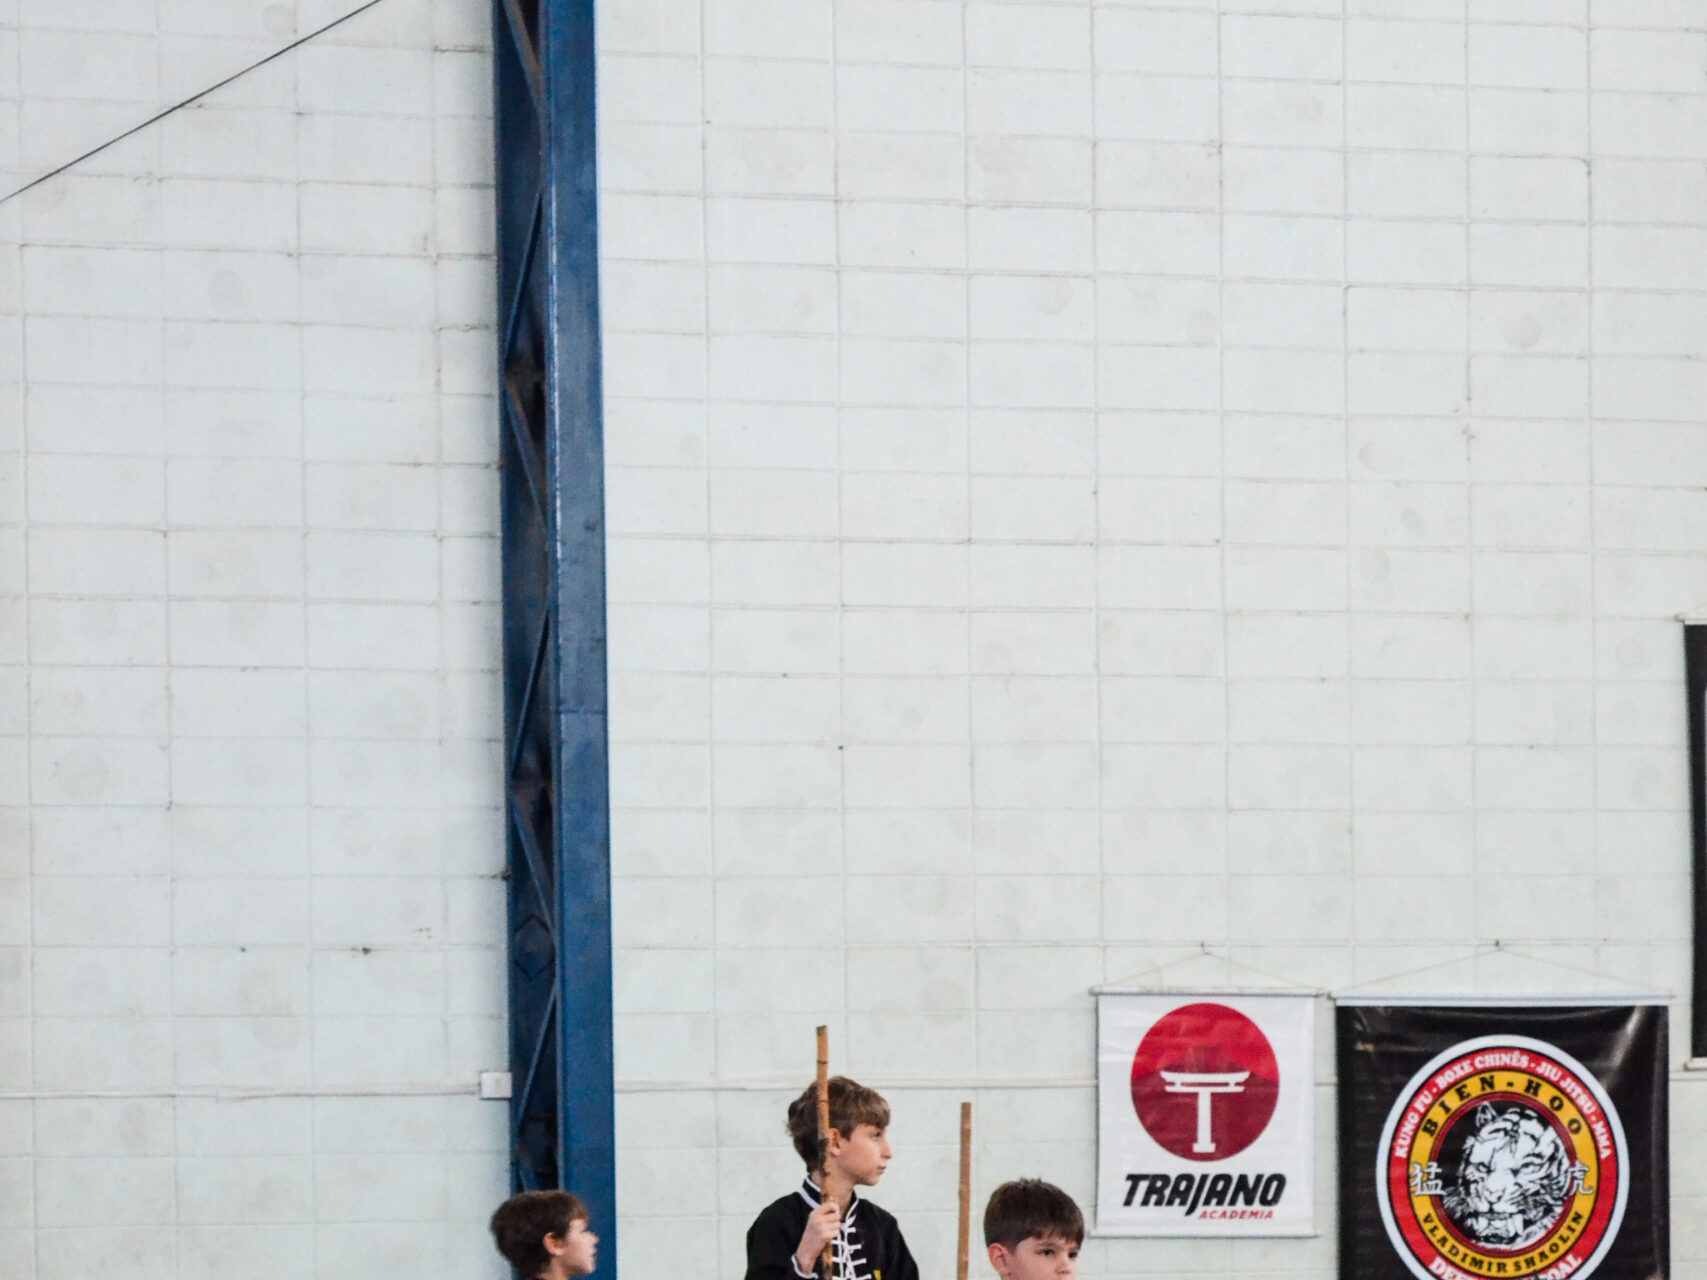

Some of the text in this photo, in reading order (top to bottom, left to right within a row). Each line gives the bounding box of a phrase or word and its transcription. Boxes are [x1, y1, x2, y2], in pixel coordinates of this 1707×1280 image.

[1395, 1051, 1612, 1160] KUNG FU BOXE CHINÊS JIU JITSU MMA
[1122, 1173, 1287, 1217] TRAJANO
[1199, 1210, 1274, 1220] ACADEMIA
[1422, 1211, 1584, 1273] VLADIMIR SHAOLIN
